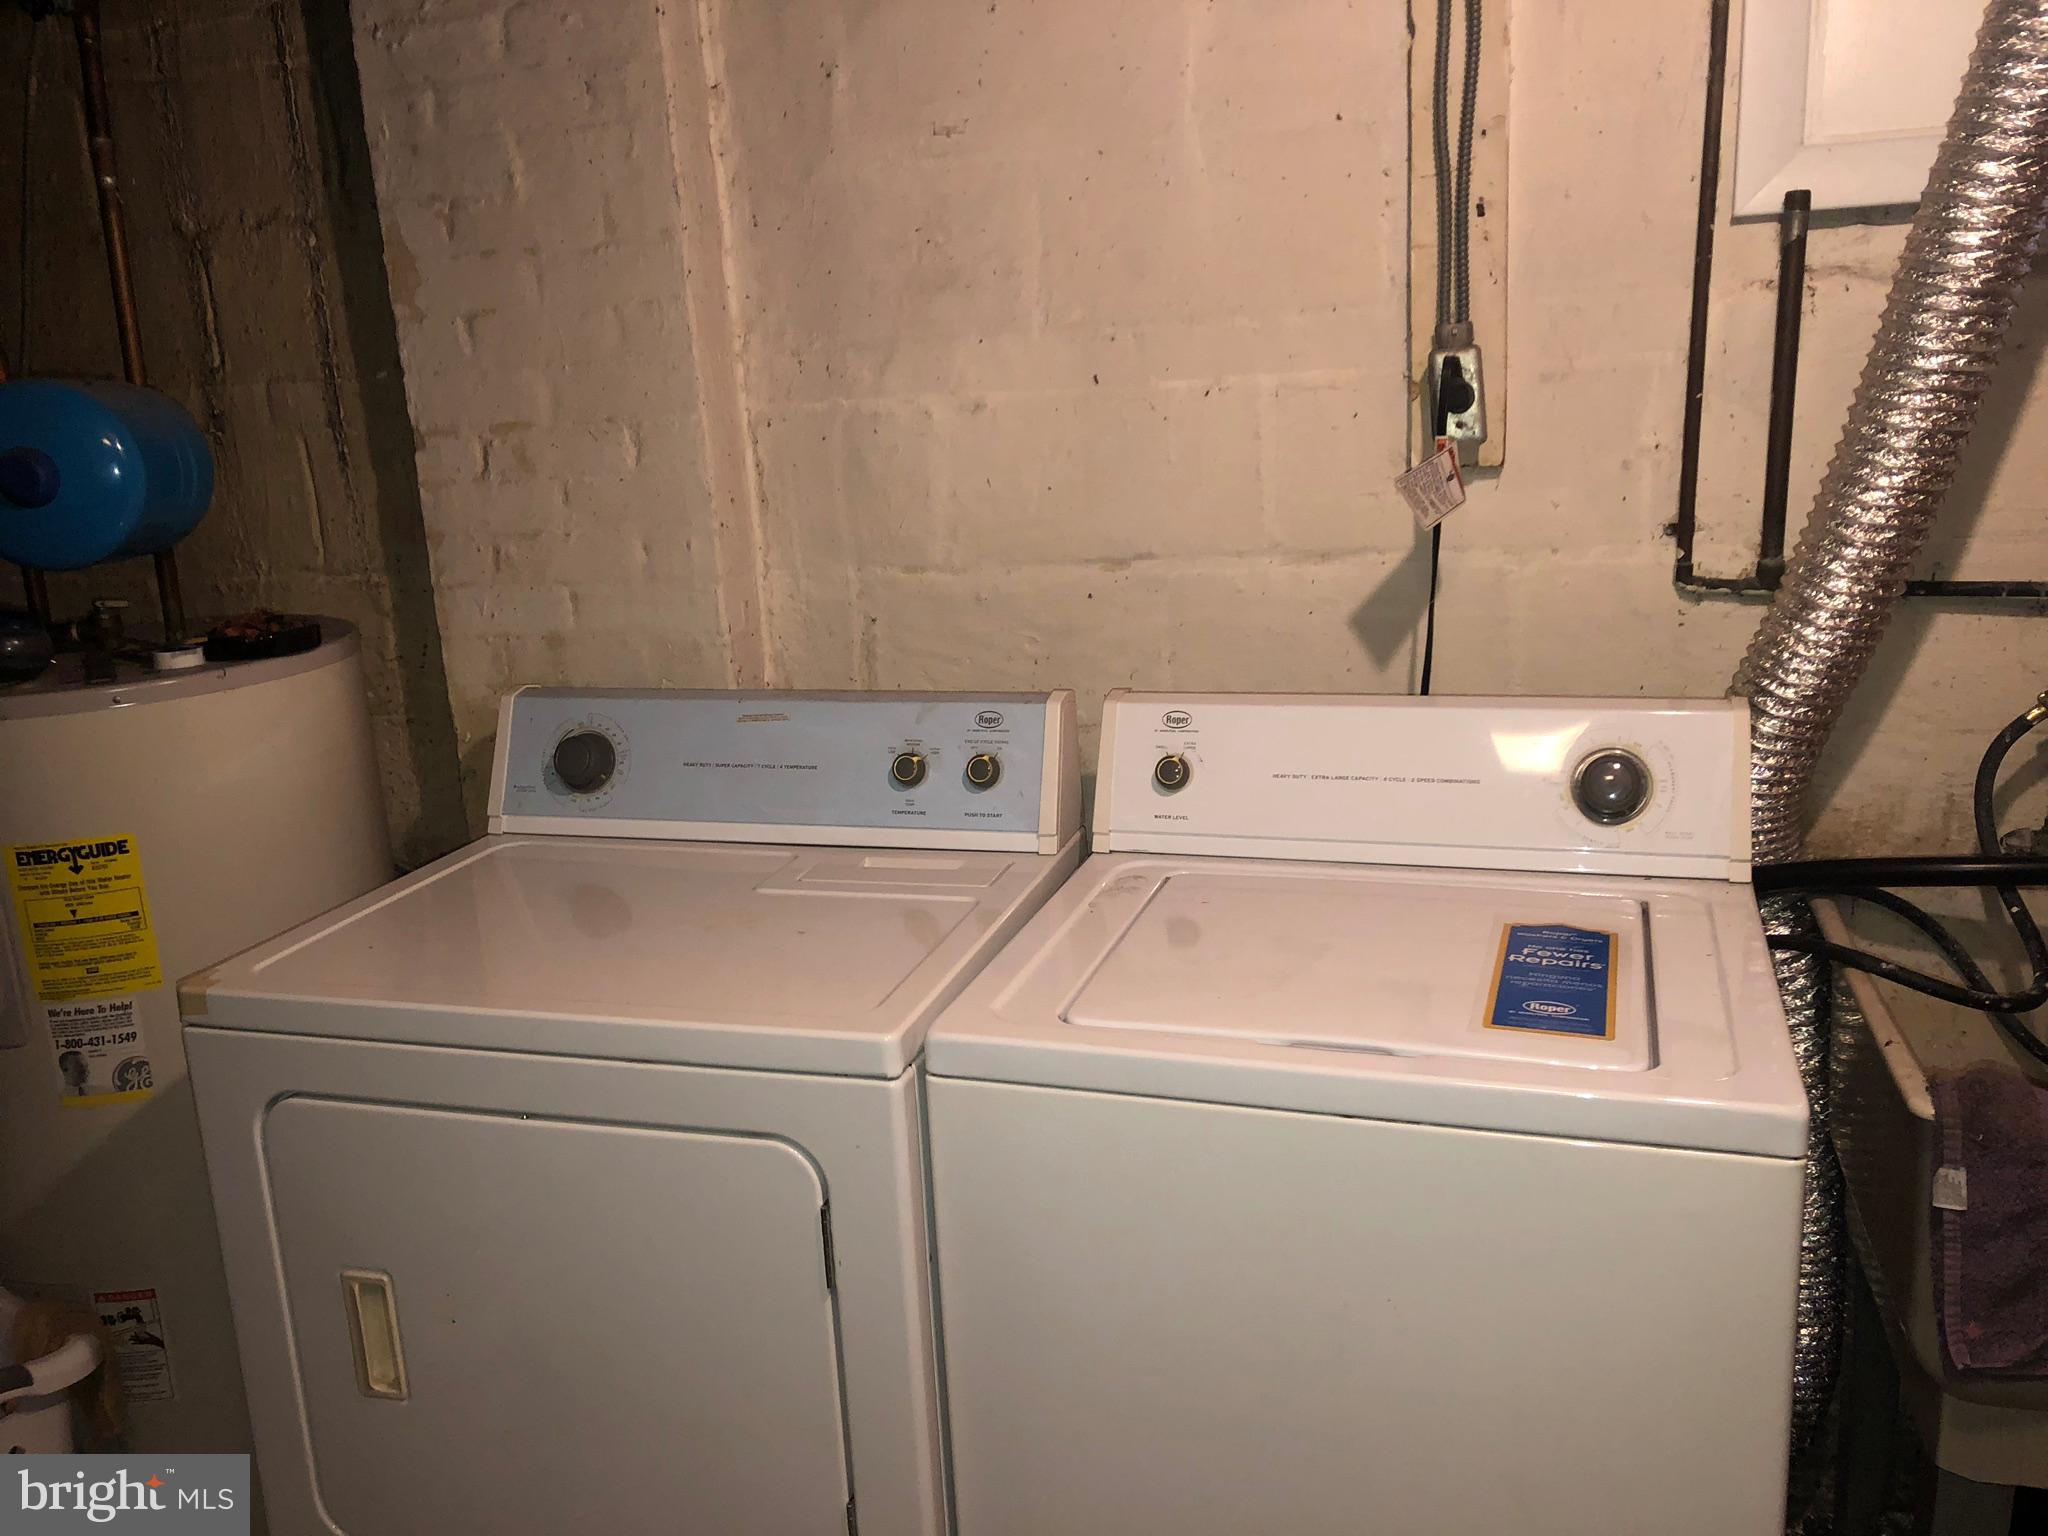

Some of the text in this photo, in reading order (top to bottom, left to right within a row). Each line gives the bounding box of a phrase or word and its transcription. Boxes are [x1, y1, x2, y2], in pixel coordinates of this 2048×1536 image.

[978, 714, 1001, 726] Roper
[1166, 714, 1190, 726] Roper
[1521, 948, 1595, 961] Fewer
[1508, 954, 1602, 970] Repairs
[48, 1001, 132, 1018] We're Here To Help!
[1529, 1002, 1571, 1014] Roper
[55, 1032, 138, 1050] 1-800-431-1549
